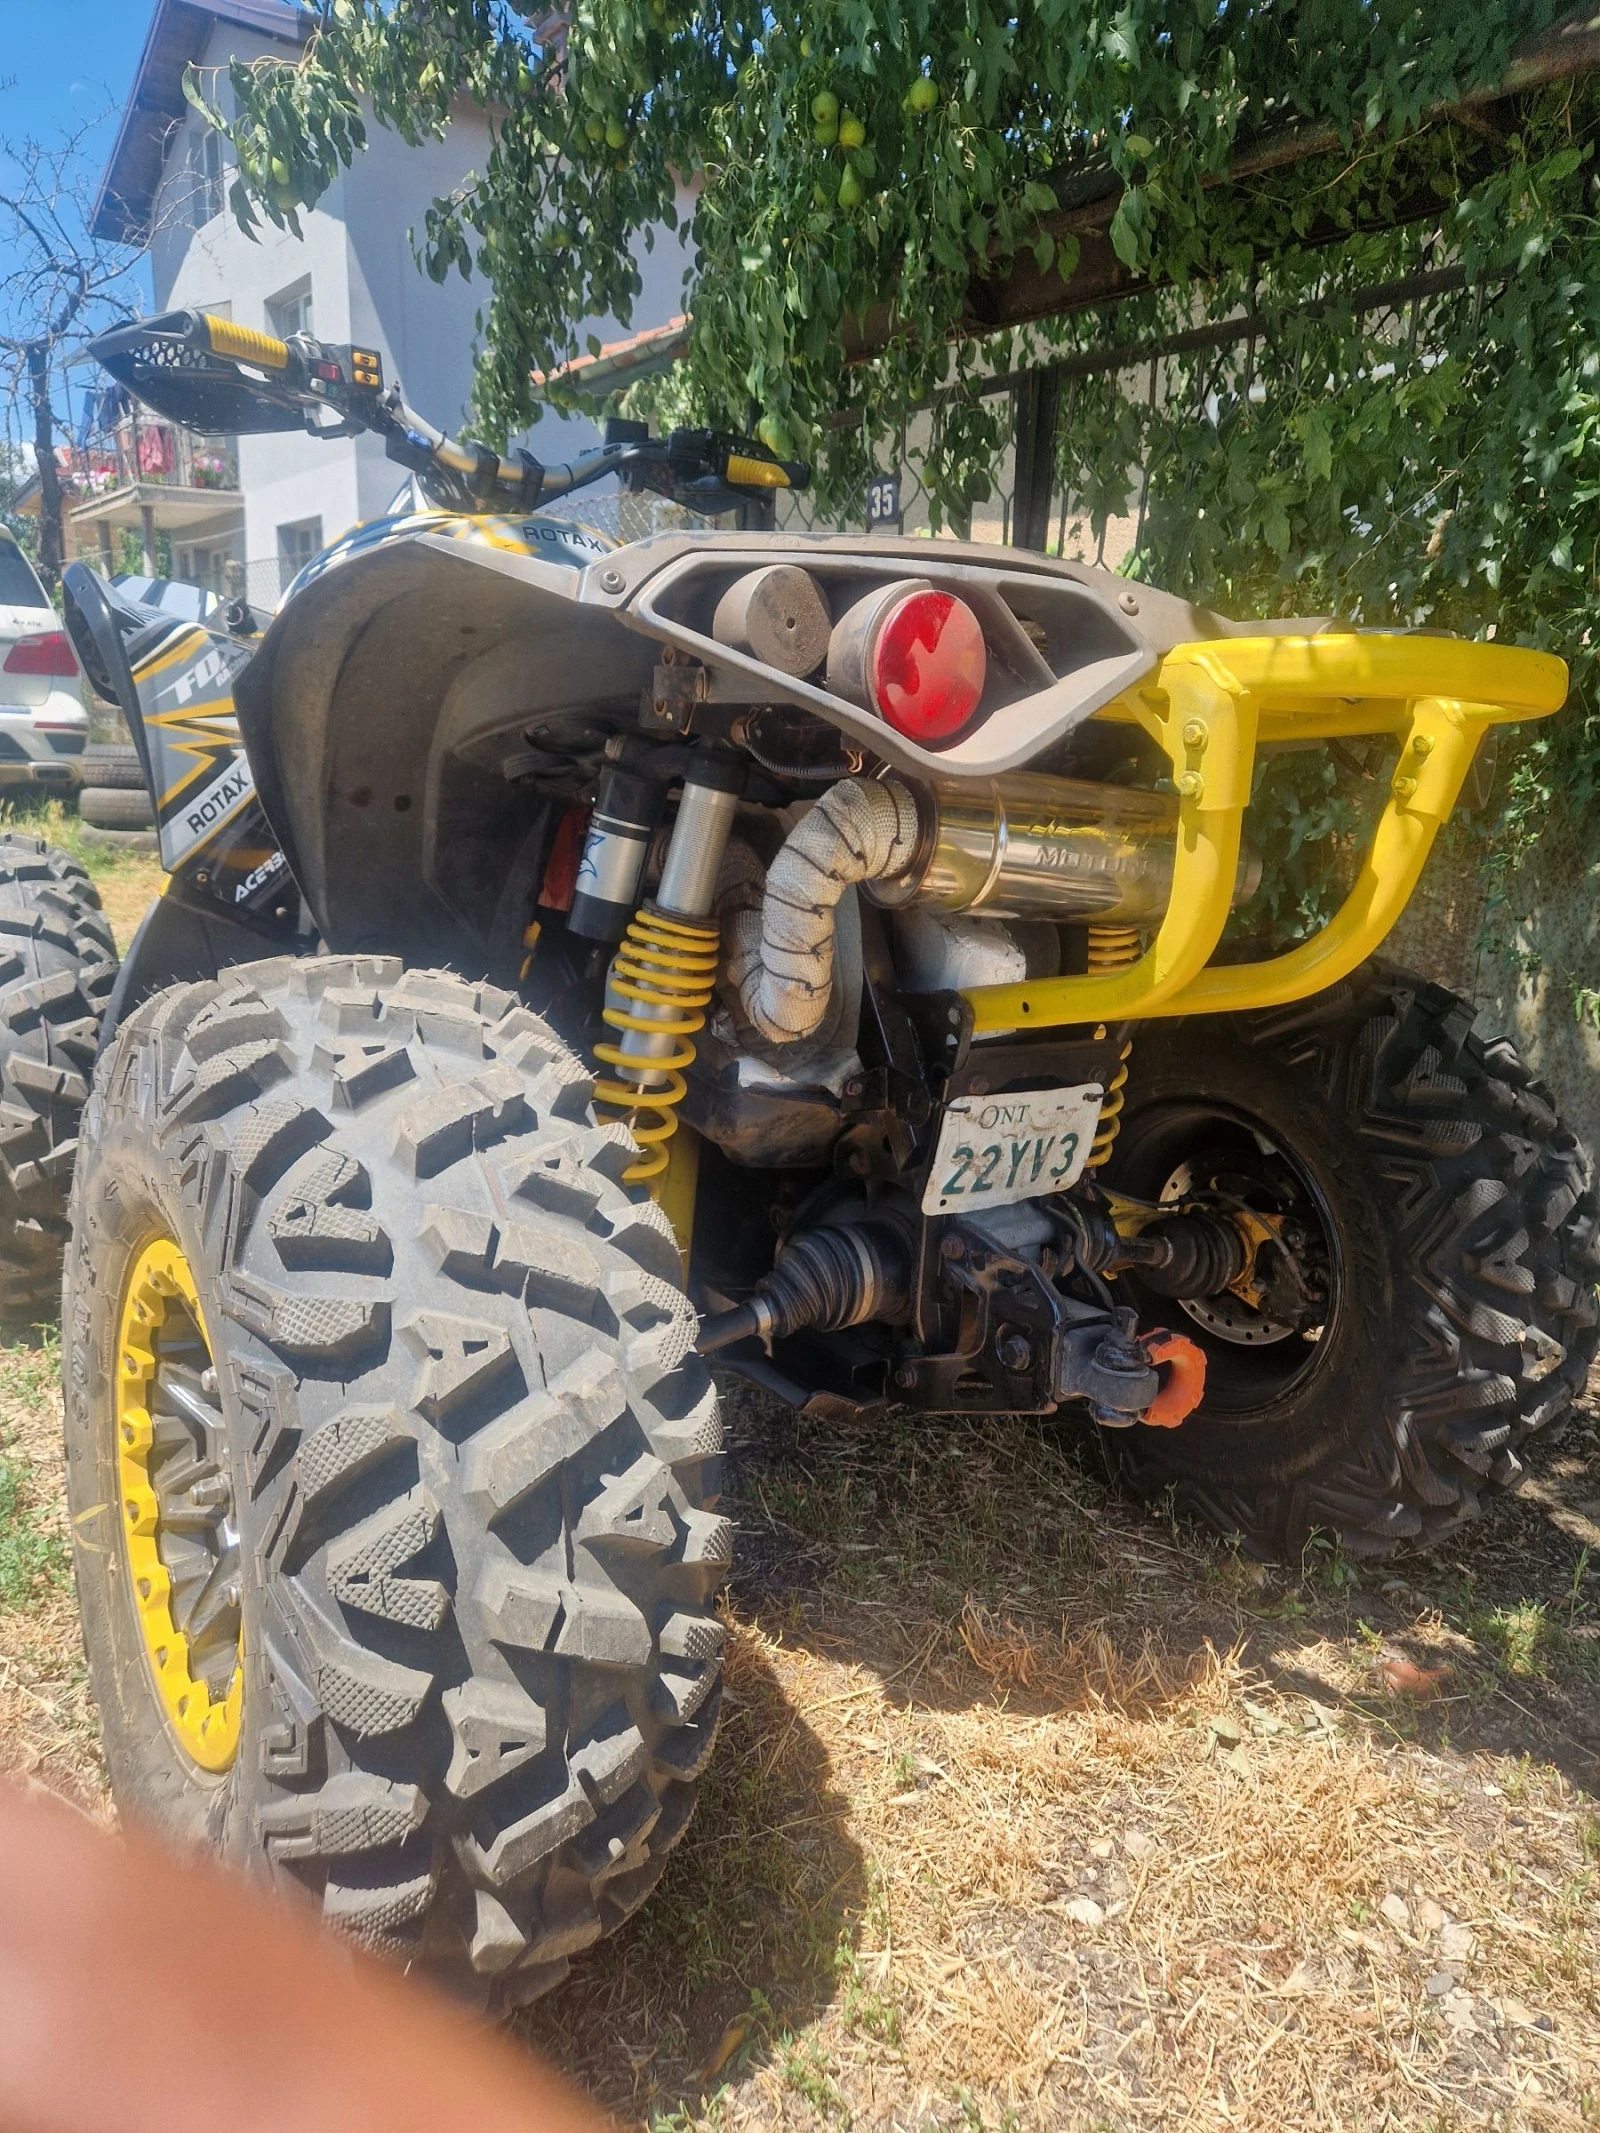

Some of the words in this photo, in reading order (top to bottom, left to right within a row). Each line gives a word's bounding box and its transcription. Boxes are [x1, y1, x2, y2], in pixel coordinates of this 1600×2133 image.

[871, 483, 893, 518] 35
[521, 526, 603, 553] ROTAX
[187, 771, 248, 834] ROTAX
[980, 1104, 1031, 1129] ONT
[941, 1132, 1079, 1196] 22YV3
